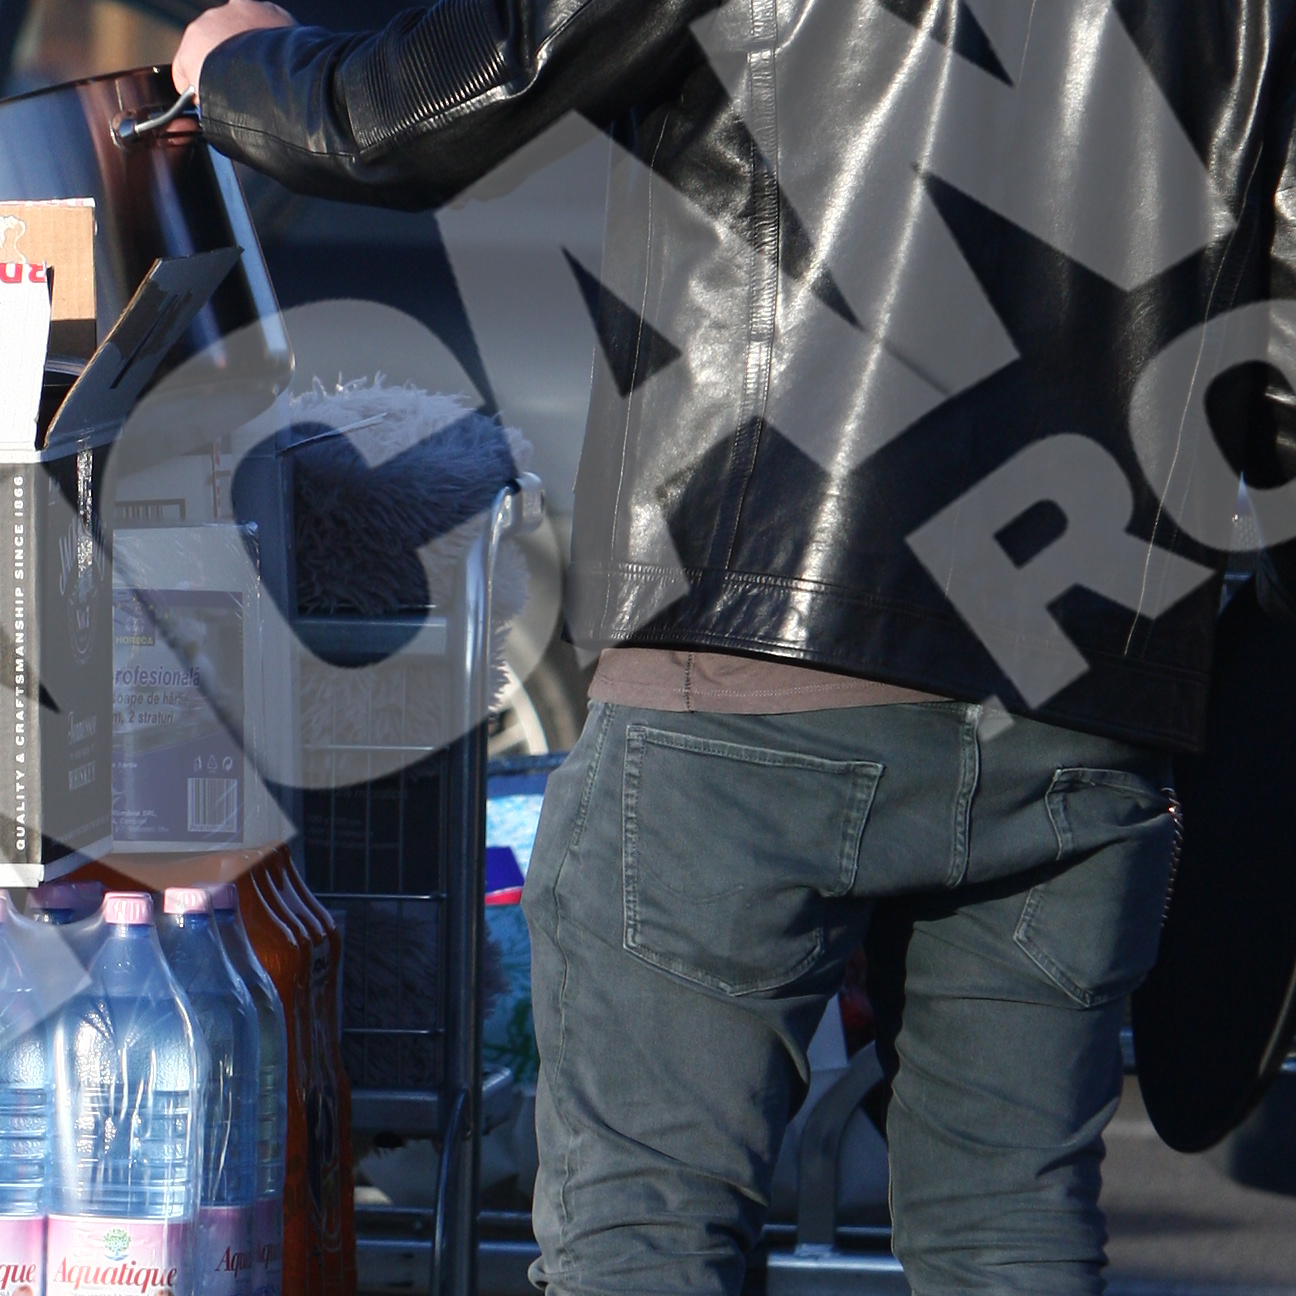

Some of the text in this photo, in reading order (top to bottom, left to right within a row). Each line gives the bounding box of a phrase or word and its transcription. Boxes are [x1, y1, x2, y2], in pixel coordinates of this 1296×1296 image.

[13, 474, 27, 851] QUALITY & CRAFTSMANSHIP SINCE 1866
[115, 665, 202, 688] rofesională
[147, 692, 160, 705] de
[128, 711, 136, 723] 2
[138, 711, 174, 724] straturi
[52, 1255, 178, 1294] Aquatique
